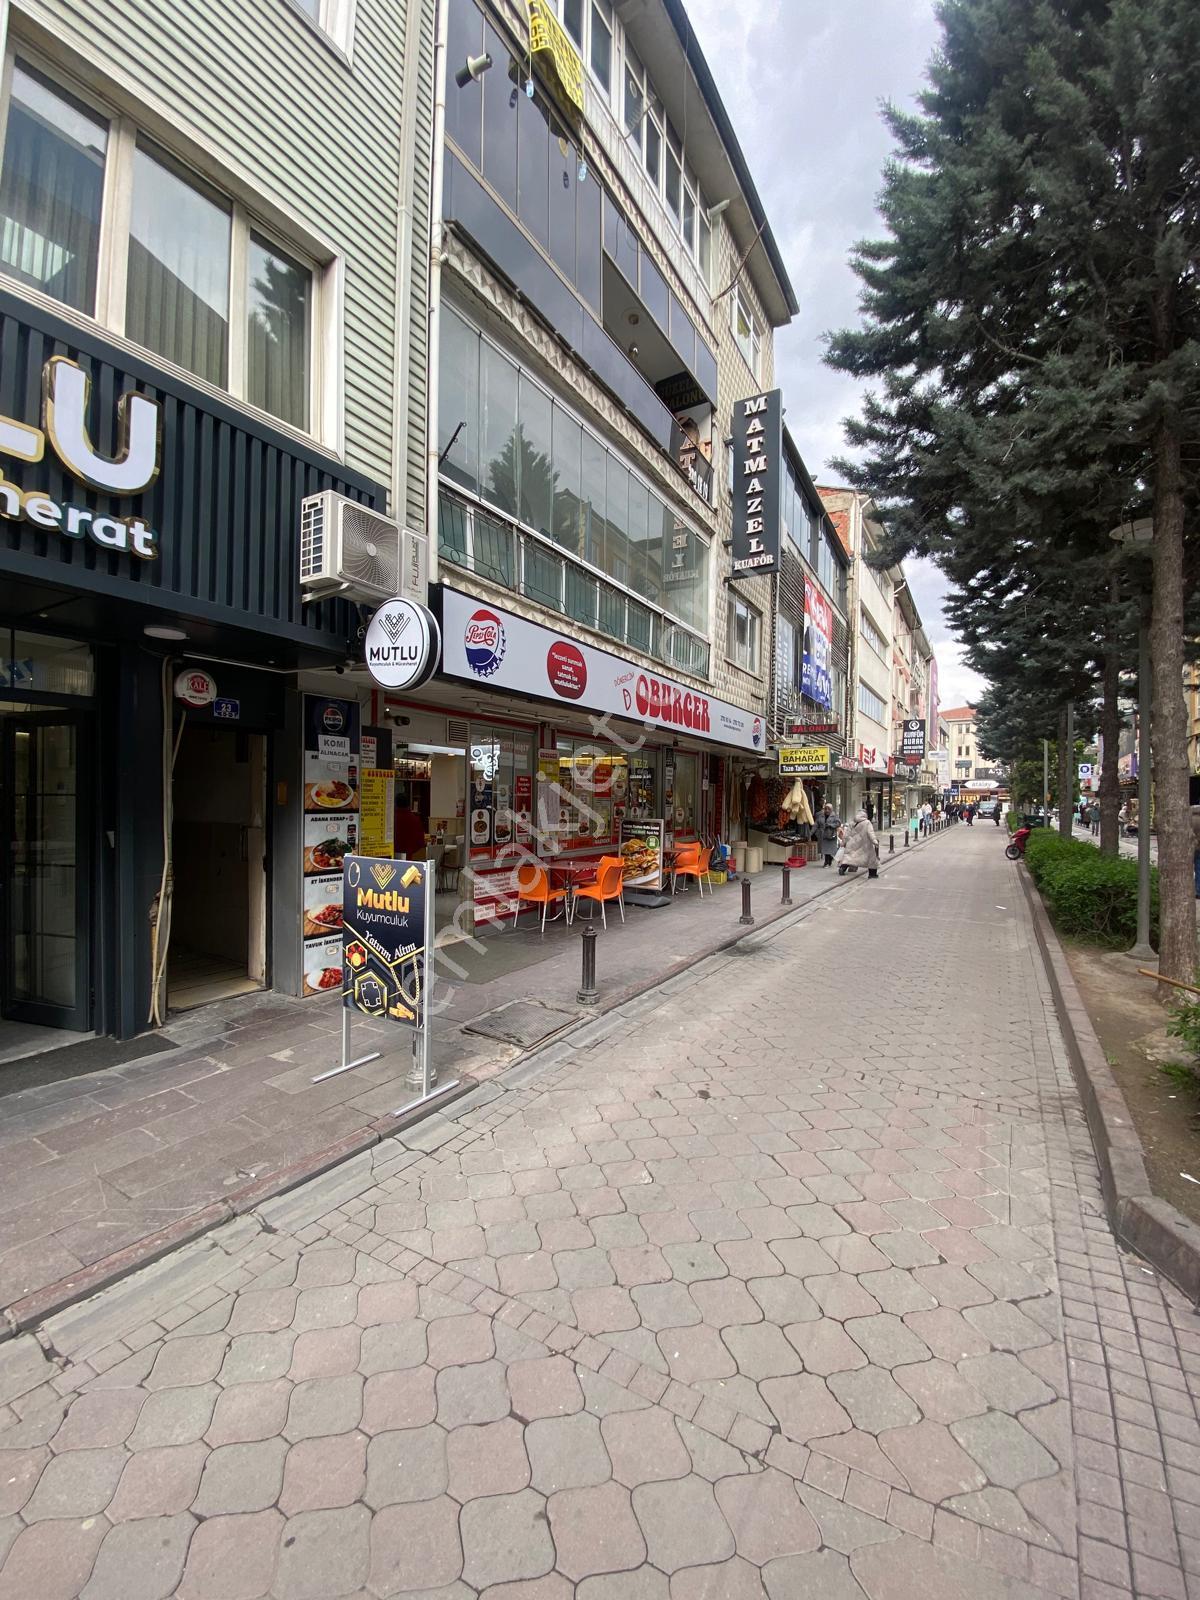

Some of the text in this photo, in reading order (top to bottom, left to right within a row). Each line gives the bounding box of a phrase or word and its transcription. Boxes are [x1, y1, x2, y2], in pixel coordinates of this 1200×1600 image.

[743, 396, 768, 553] MATMAZEL
[734, 554, 774, 571] KUAFÖR
[369, 646, 418, 661] MUTLU
[221, 703, 232, 712] 23
[782, 755, 826, 763] BAHARAT
[796, 764, 809, 772] Tahin
[356, 887, 410, 913] Mutlu
[356, 909, 408, 928] Kuyumculuk
